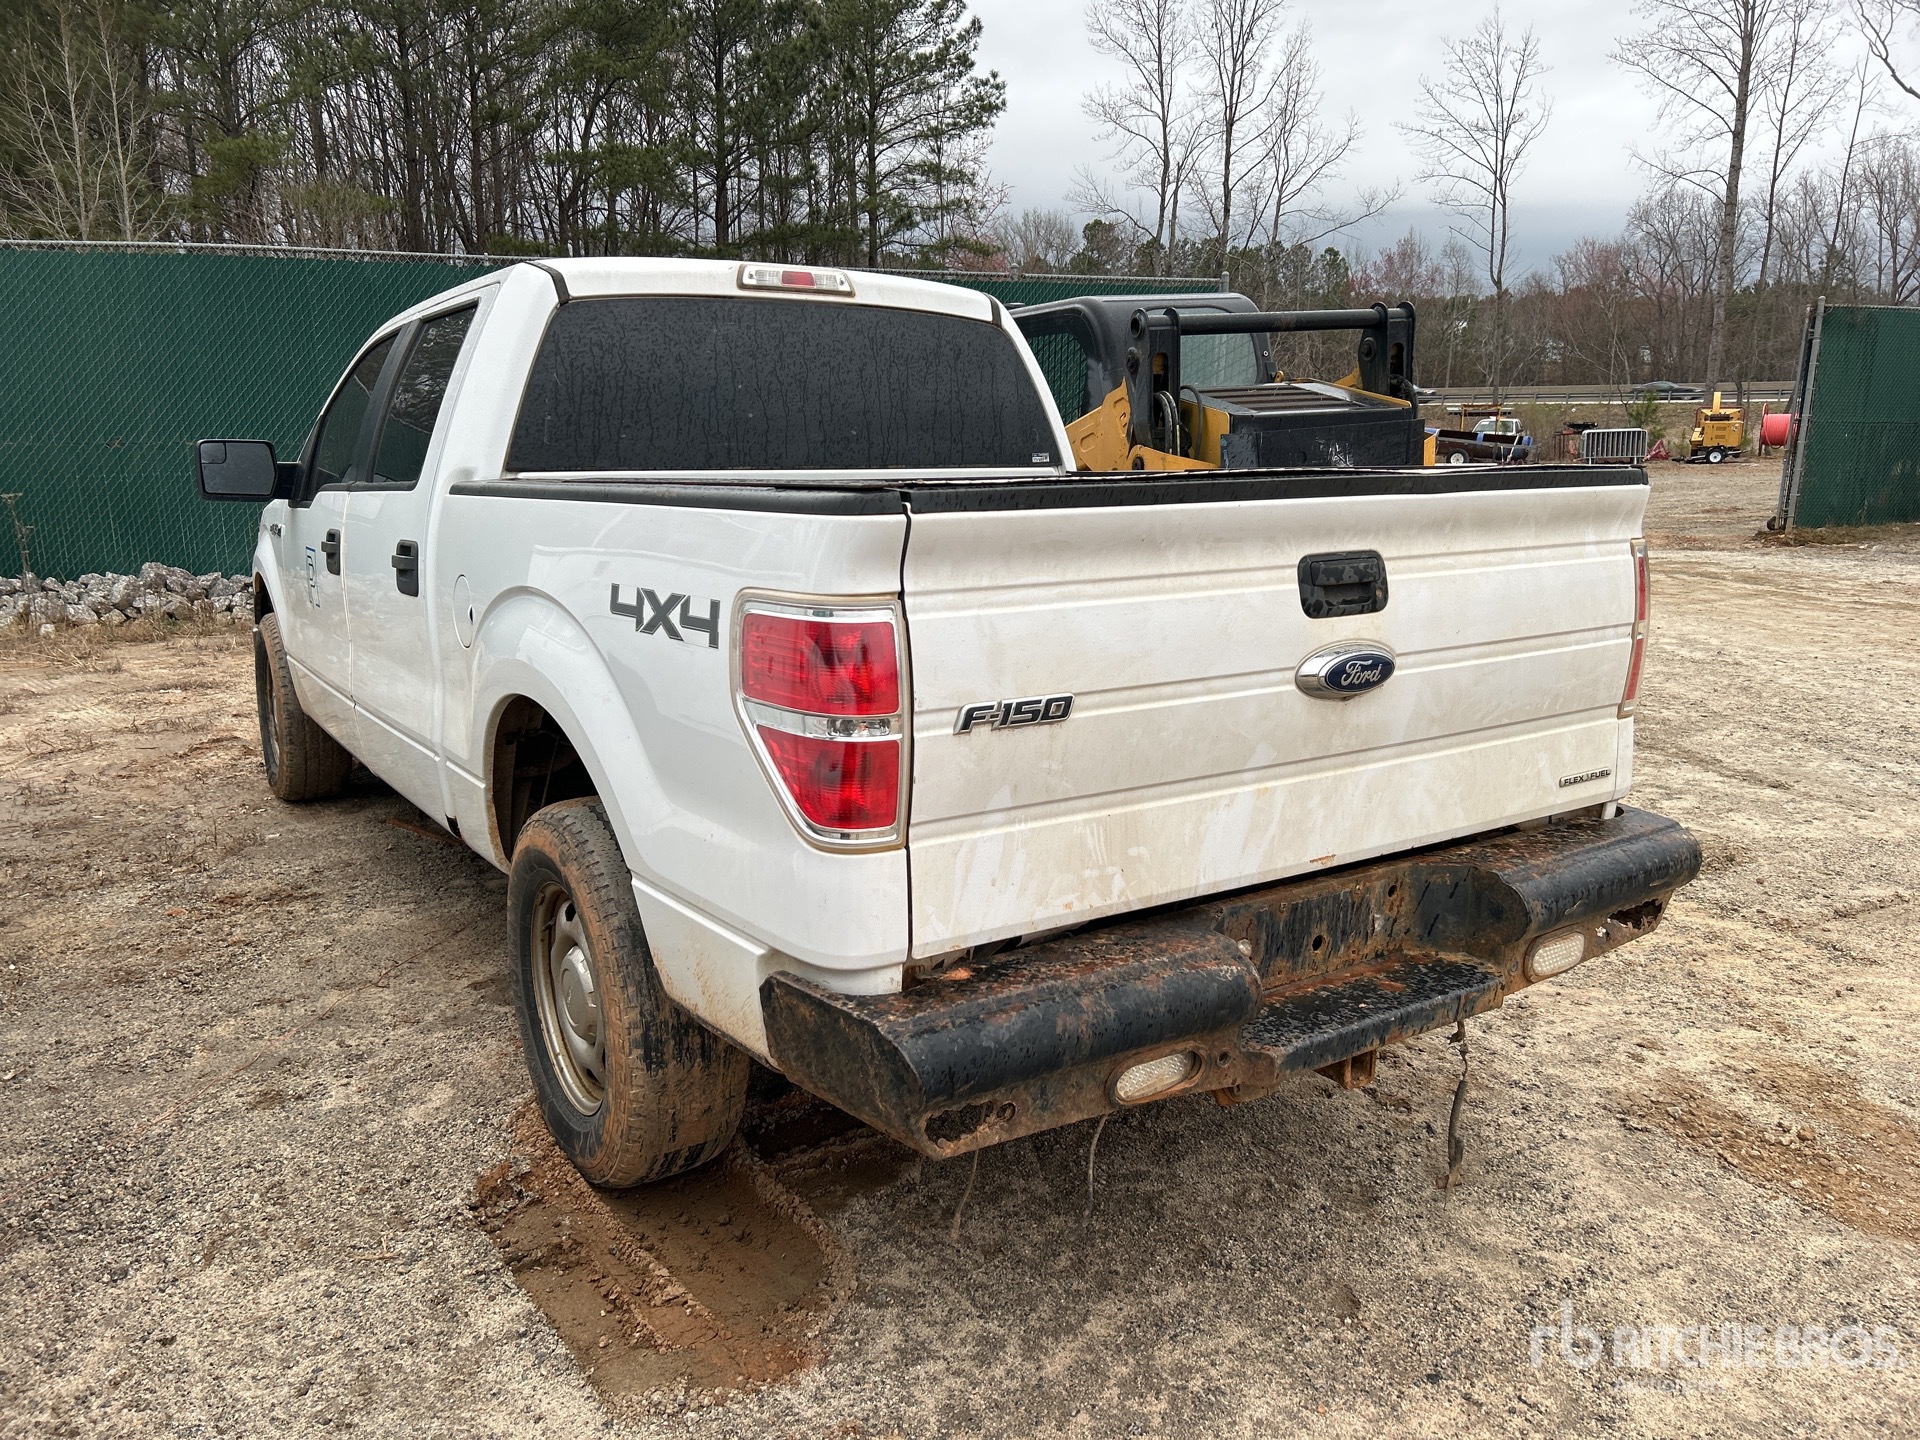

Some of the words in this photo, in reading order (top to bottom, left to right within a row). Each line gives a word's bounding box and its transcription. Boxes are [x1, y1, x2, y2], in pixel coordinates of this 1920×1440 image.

[1341, 660, 1382, 686] Ford
[953, 692, 1075, 735] F-150
[1563, 774, 1584, 786] FLEX
[1590, 769, 1611, 780] FUEL
